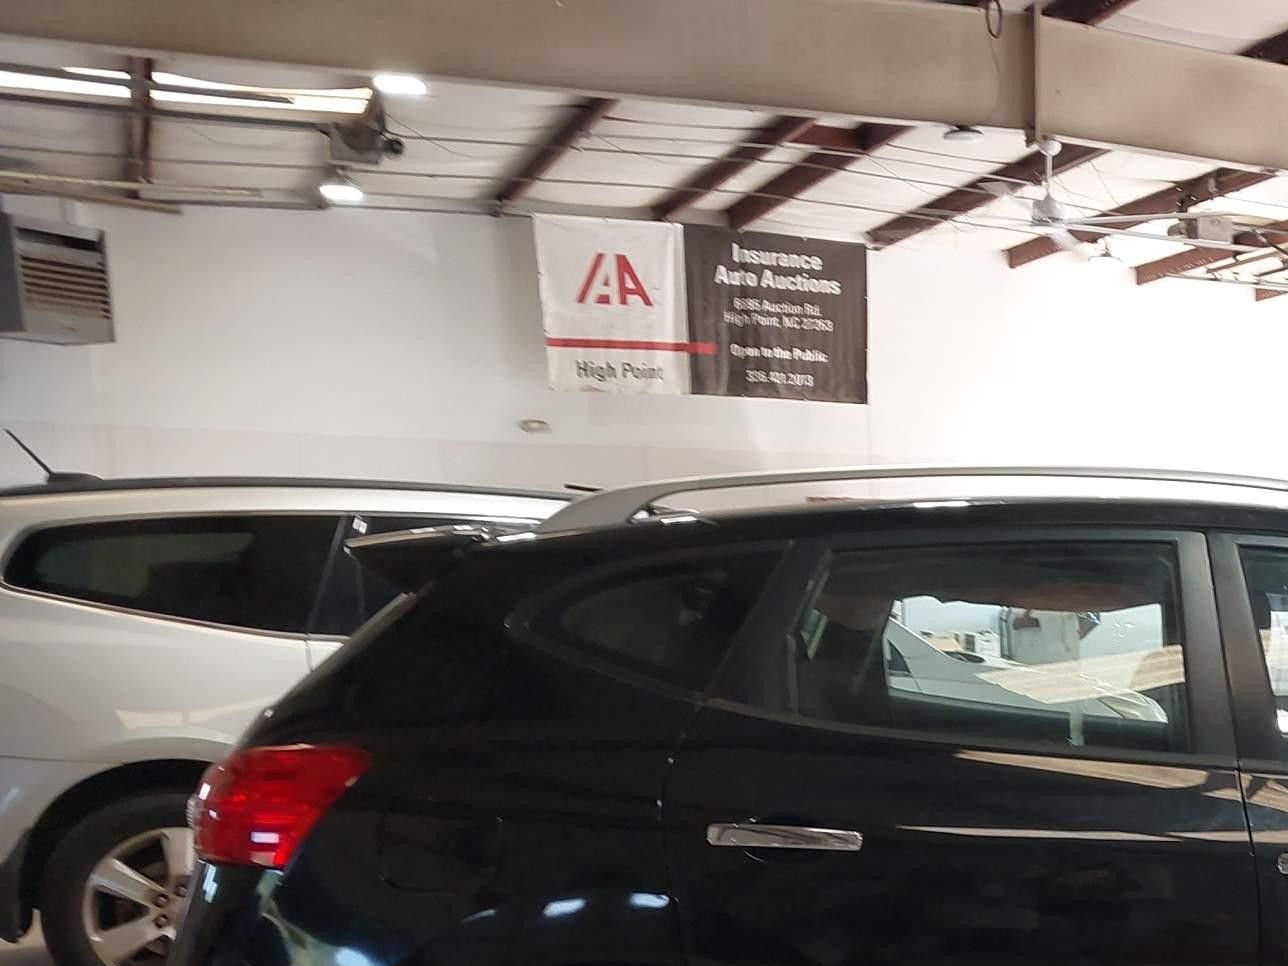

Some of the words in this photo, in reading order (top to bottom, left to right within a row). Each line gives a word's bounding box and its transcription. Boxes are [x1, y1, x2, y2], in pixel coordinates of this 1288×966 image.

[731, 242, 823, 271] Insurance
[714, 264, 758, 287] Auto
[759, 269, 842, 295] Auctions
[761, 299, 804, 315] Auction
[723, 311, 751, 328] High
[782, 315, 801, 329] NC
[730, 343, 760, 360] Open
[773, 346, 793, 360] the
[792, 347, 829, 363] Public
[576, 359, 618, 382] High
[620, 360, 665, 381] Point
